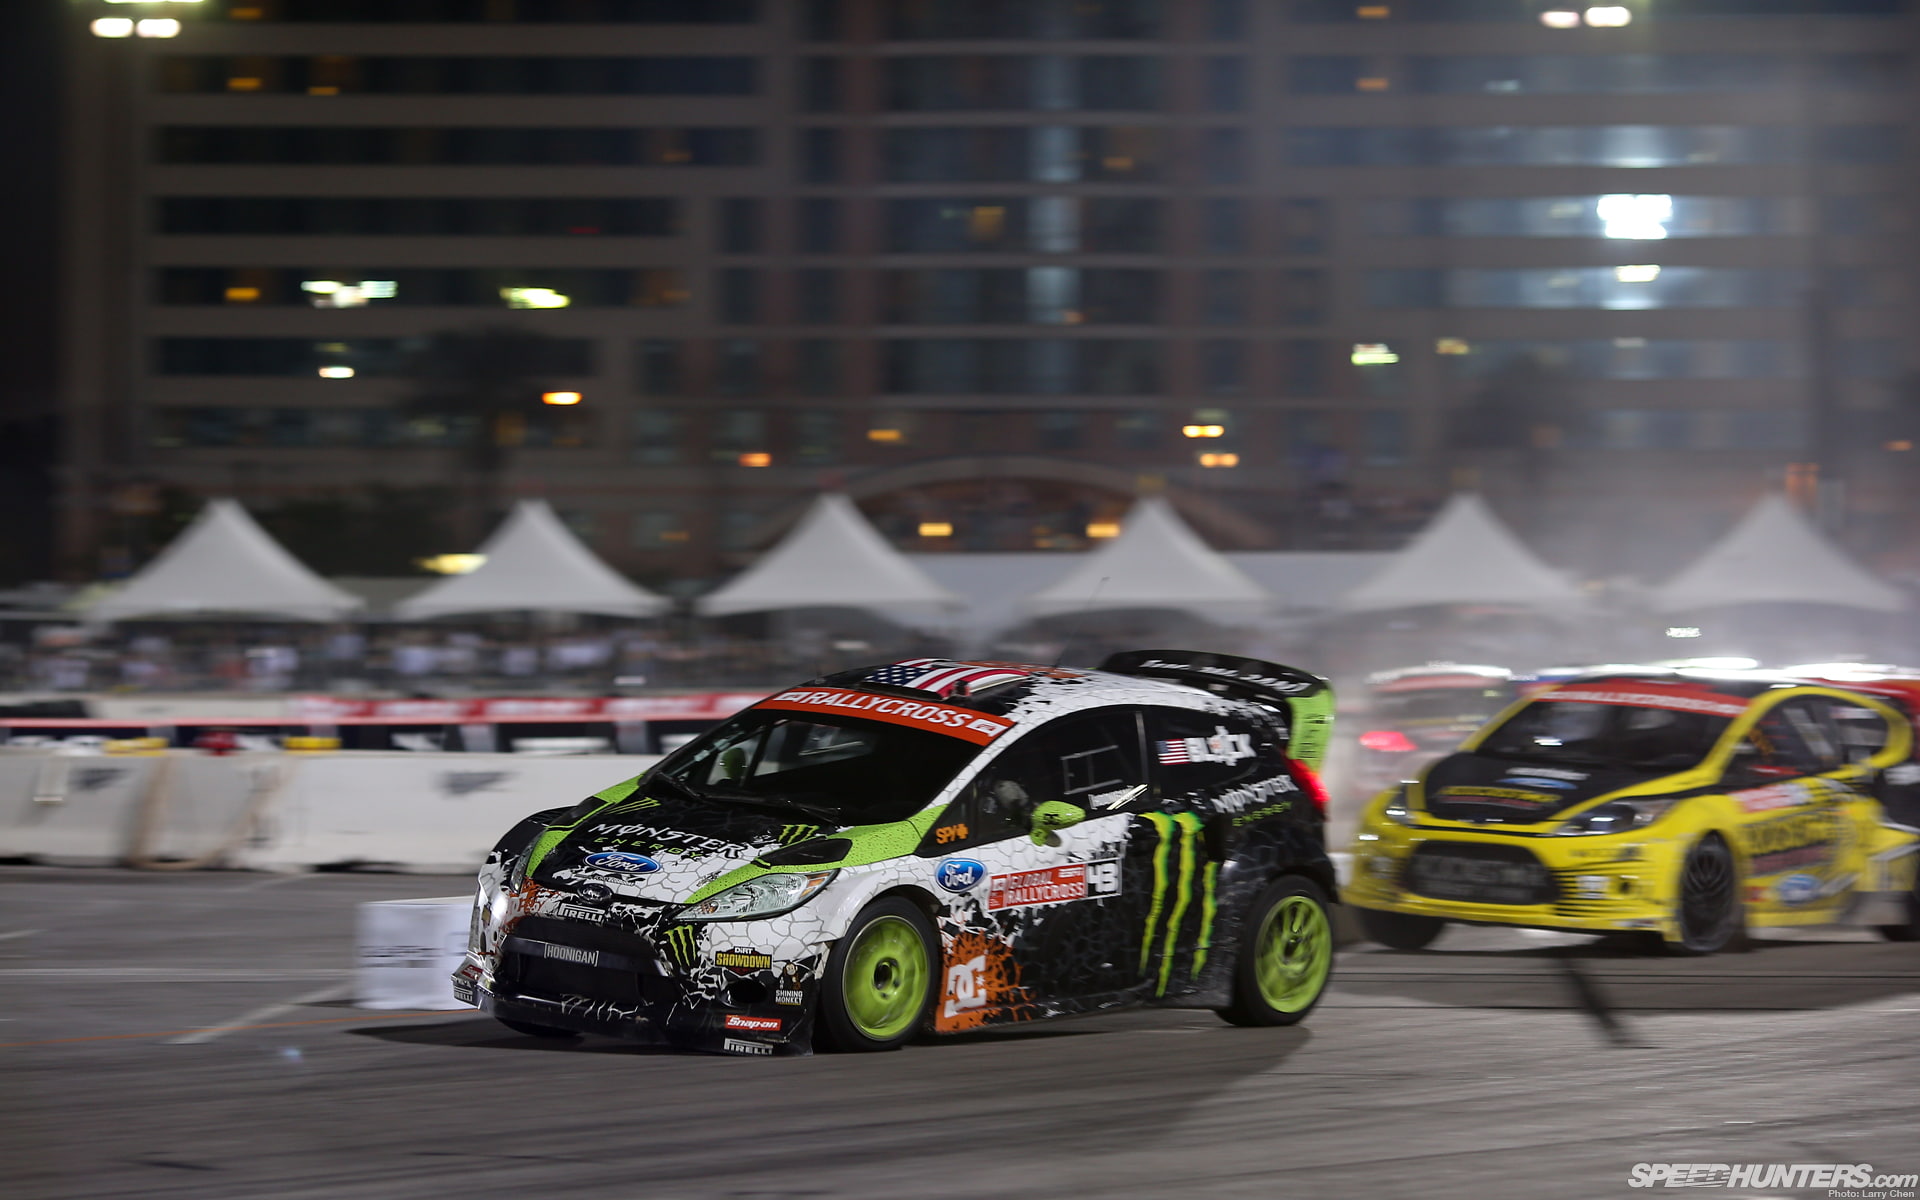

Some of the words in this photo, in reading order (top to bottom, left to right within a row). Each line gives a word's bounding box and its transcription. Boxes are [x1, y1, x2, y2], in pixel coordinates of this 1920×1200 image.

[798, 691, 974, 728] RALLYCROSS
[593, 837, 704, 859] ENERGY
[595, 853, 646, 872] Ford
[945, 862, 976, 887] Ford
[1008, 871, 1054, 890] GLOBAL
[1007, 882, 1084, 905] RALLYCROSS
[558, 903, 606, 922] PIRELLI
[716, 953, 771, 969] SHOWDOWN
[775, 989, 803, 998] SHINING
[775, 996, 803, 1005] MONKEY
[727, 1017, 778, 1029] Snap-on
[724, 1037, 774, 1055] PIRELLI
